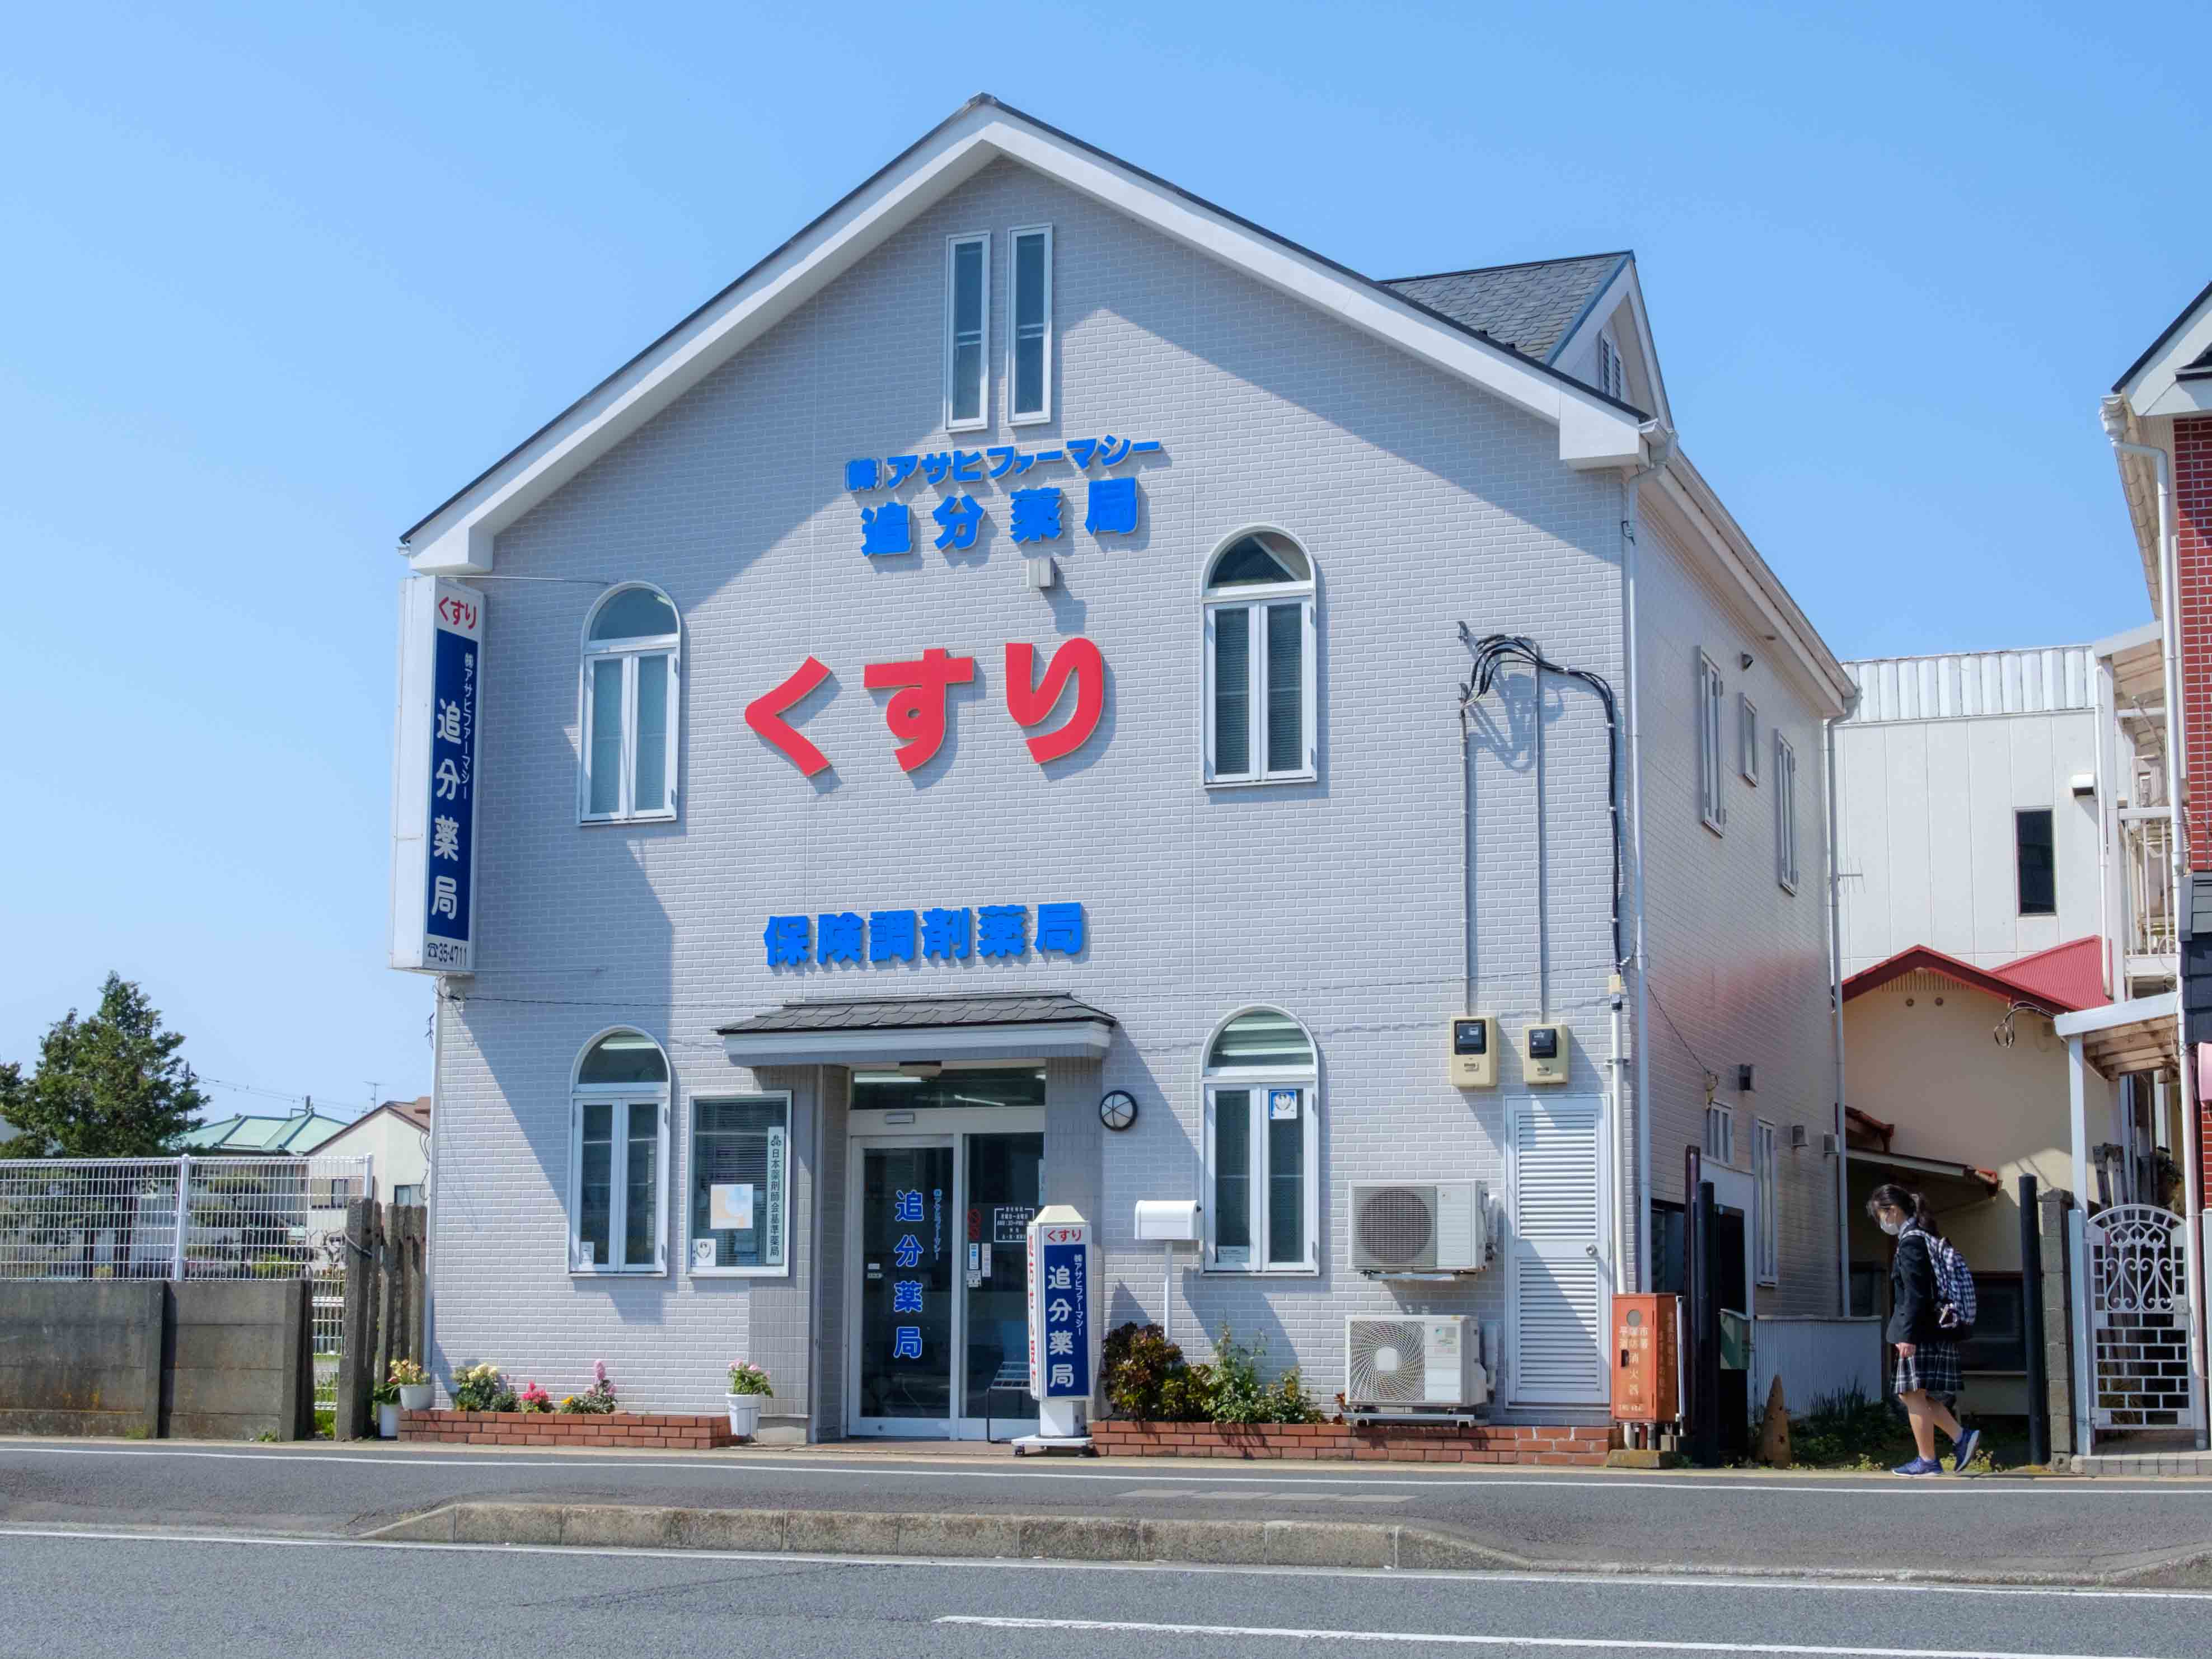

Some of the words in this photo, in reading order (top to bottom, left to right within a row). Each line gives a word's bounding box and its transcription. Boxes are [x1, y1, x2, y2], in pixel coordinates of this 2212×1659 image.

[860, 477, 1138, 556] 追分薬局
[439, 597, 477, 630] くすり
[744, 638, 1104, 777] くすり
[431, 699, 462, 920] 追分薬局
[763, 902, 1084, 967] 保険調剤薬局
[893, 1190, 924, 1358] 追分薬局
[1048, 1229, 1081, 1241] くすり
[1048, 1265, 1074, 1388] 追分薬局
